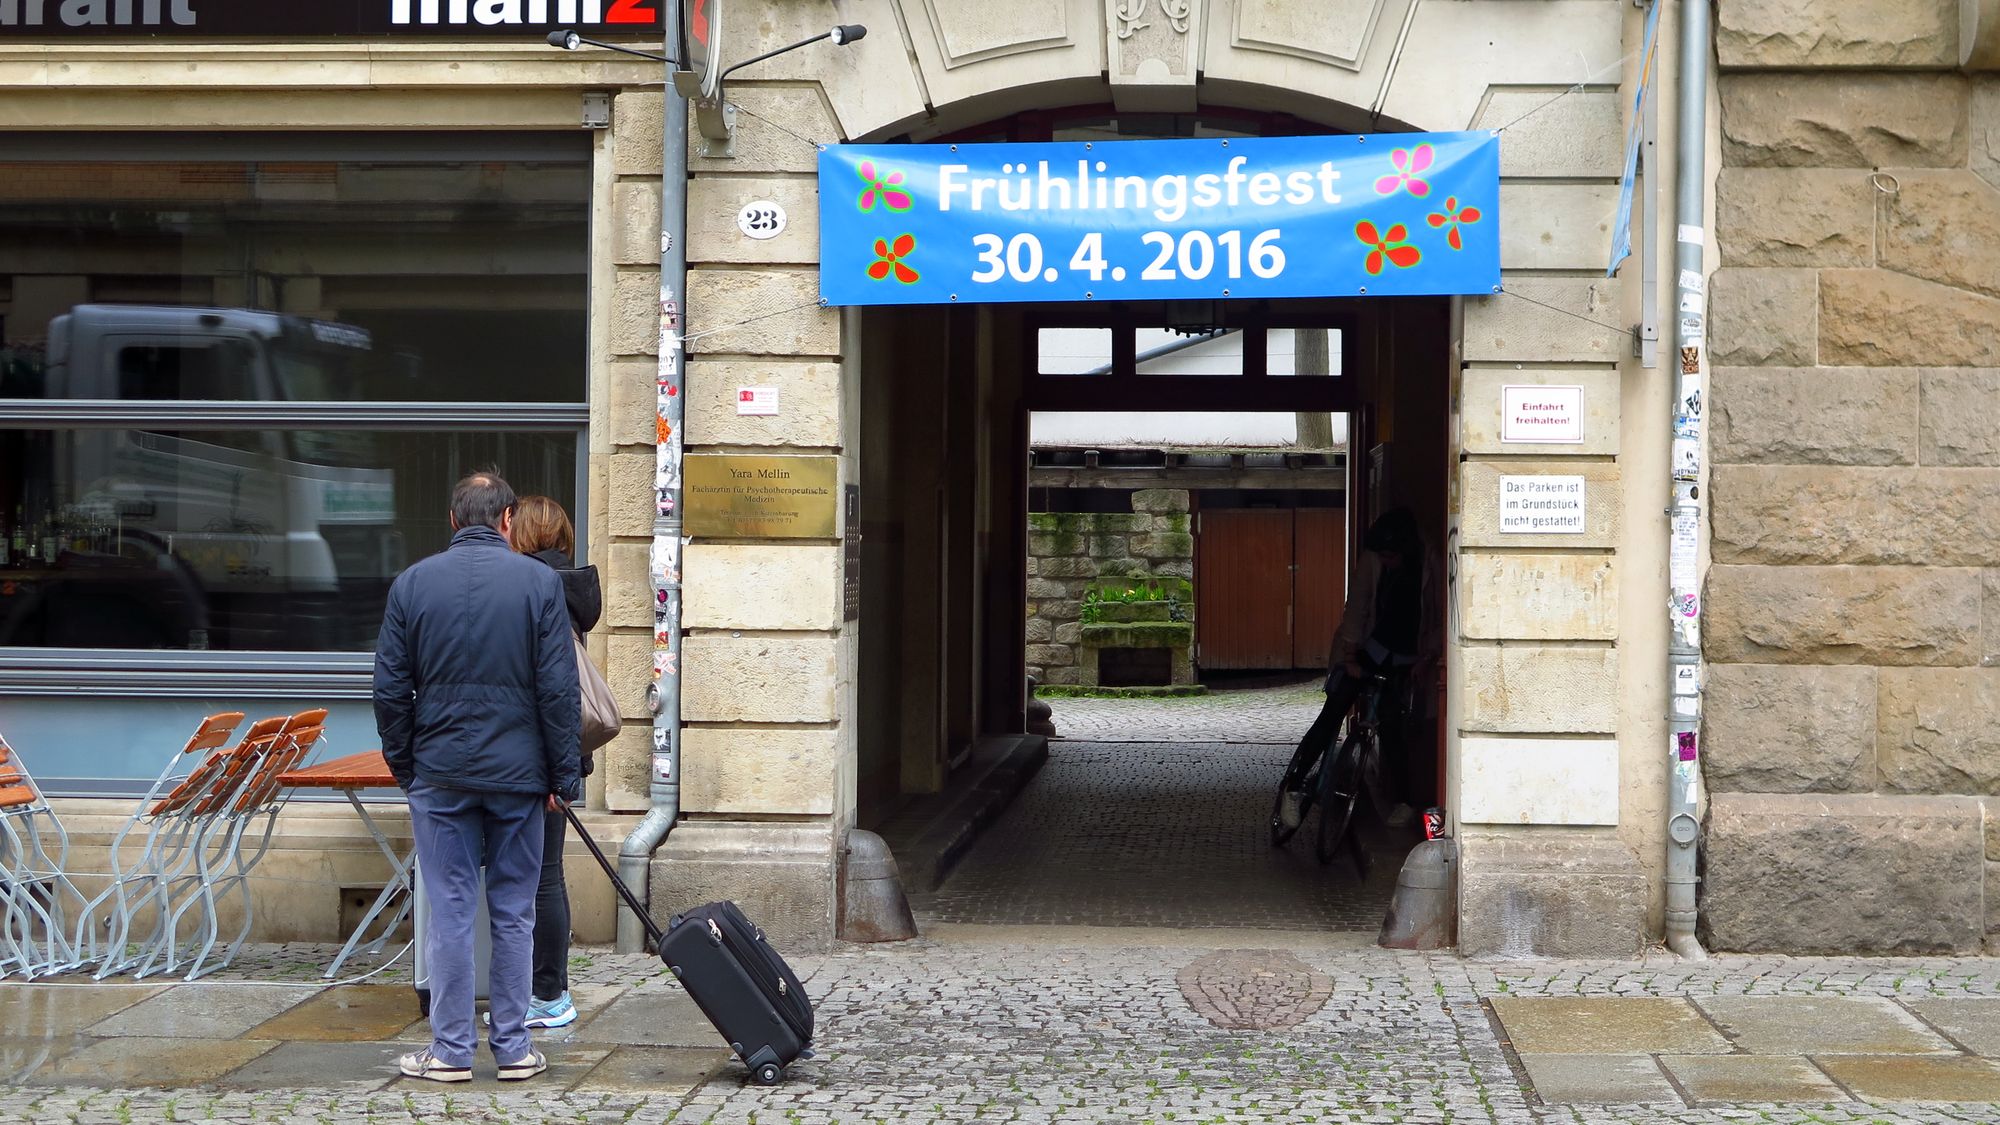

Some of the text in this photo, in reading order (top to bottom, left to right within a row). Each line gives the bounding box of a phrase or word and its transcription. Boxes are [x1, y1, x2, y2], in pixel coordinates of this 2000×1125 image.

[937, 156, 1342, 223] Frühlingsfest
[746, 209, 778, 230] 23
[970, 228, 1287, 284] 30. 4. 2016
[1522, 403, 1565, 411] Einfahrt
[1516, 416, 1570, 425] freihalten!
[730, 468, 791, 479] Yara Mellin
[691, 485, 829, 495] Fachärztin für Psychotherapeutische
[1506, 481, 1579, 493] Das Parken ist
[744, 495, 775, 504] Medizin
[1506, 498, 1579, 510] im Grundstück
[1504, 516, 1580, 529] nicht gestattet!
